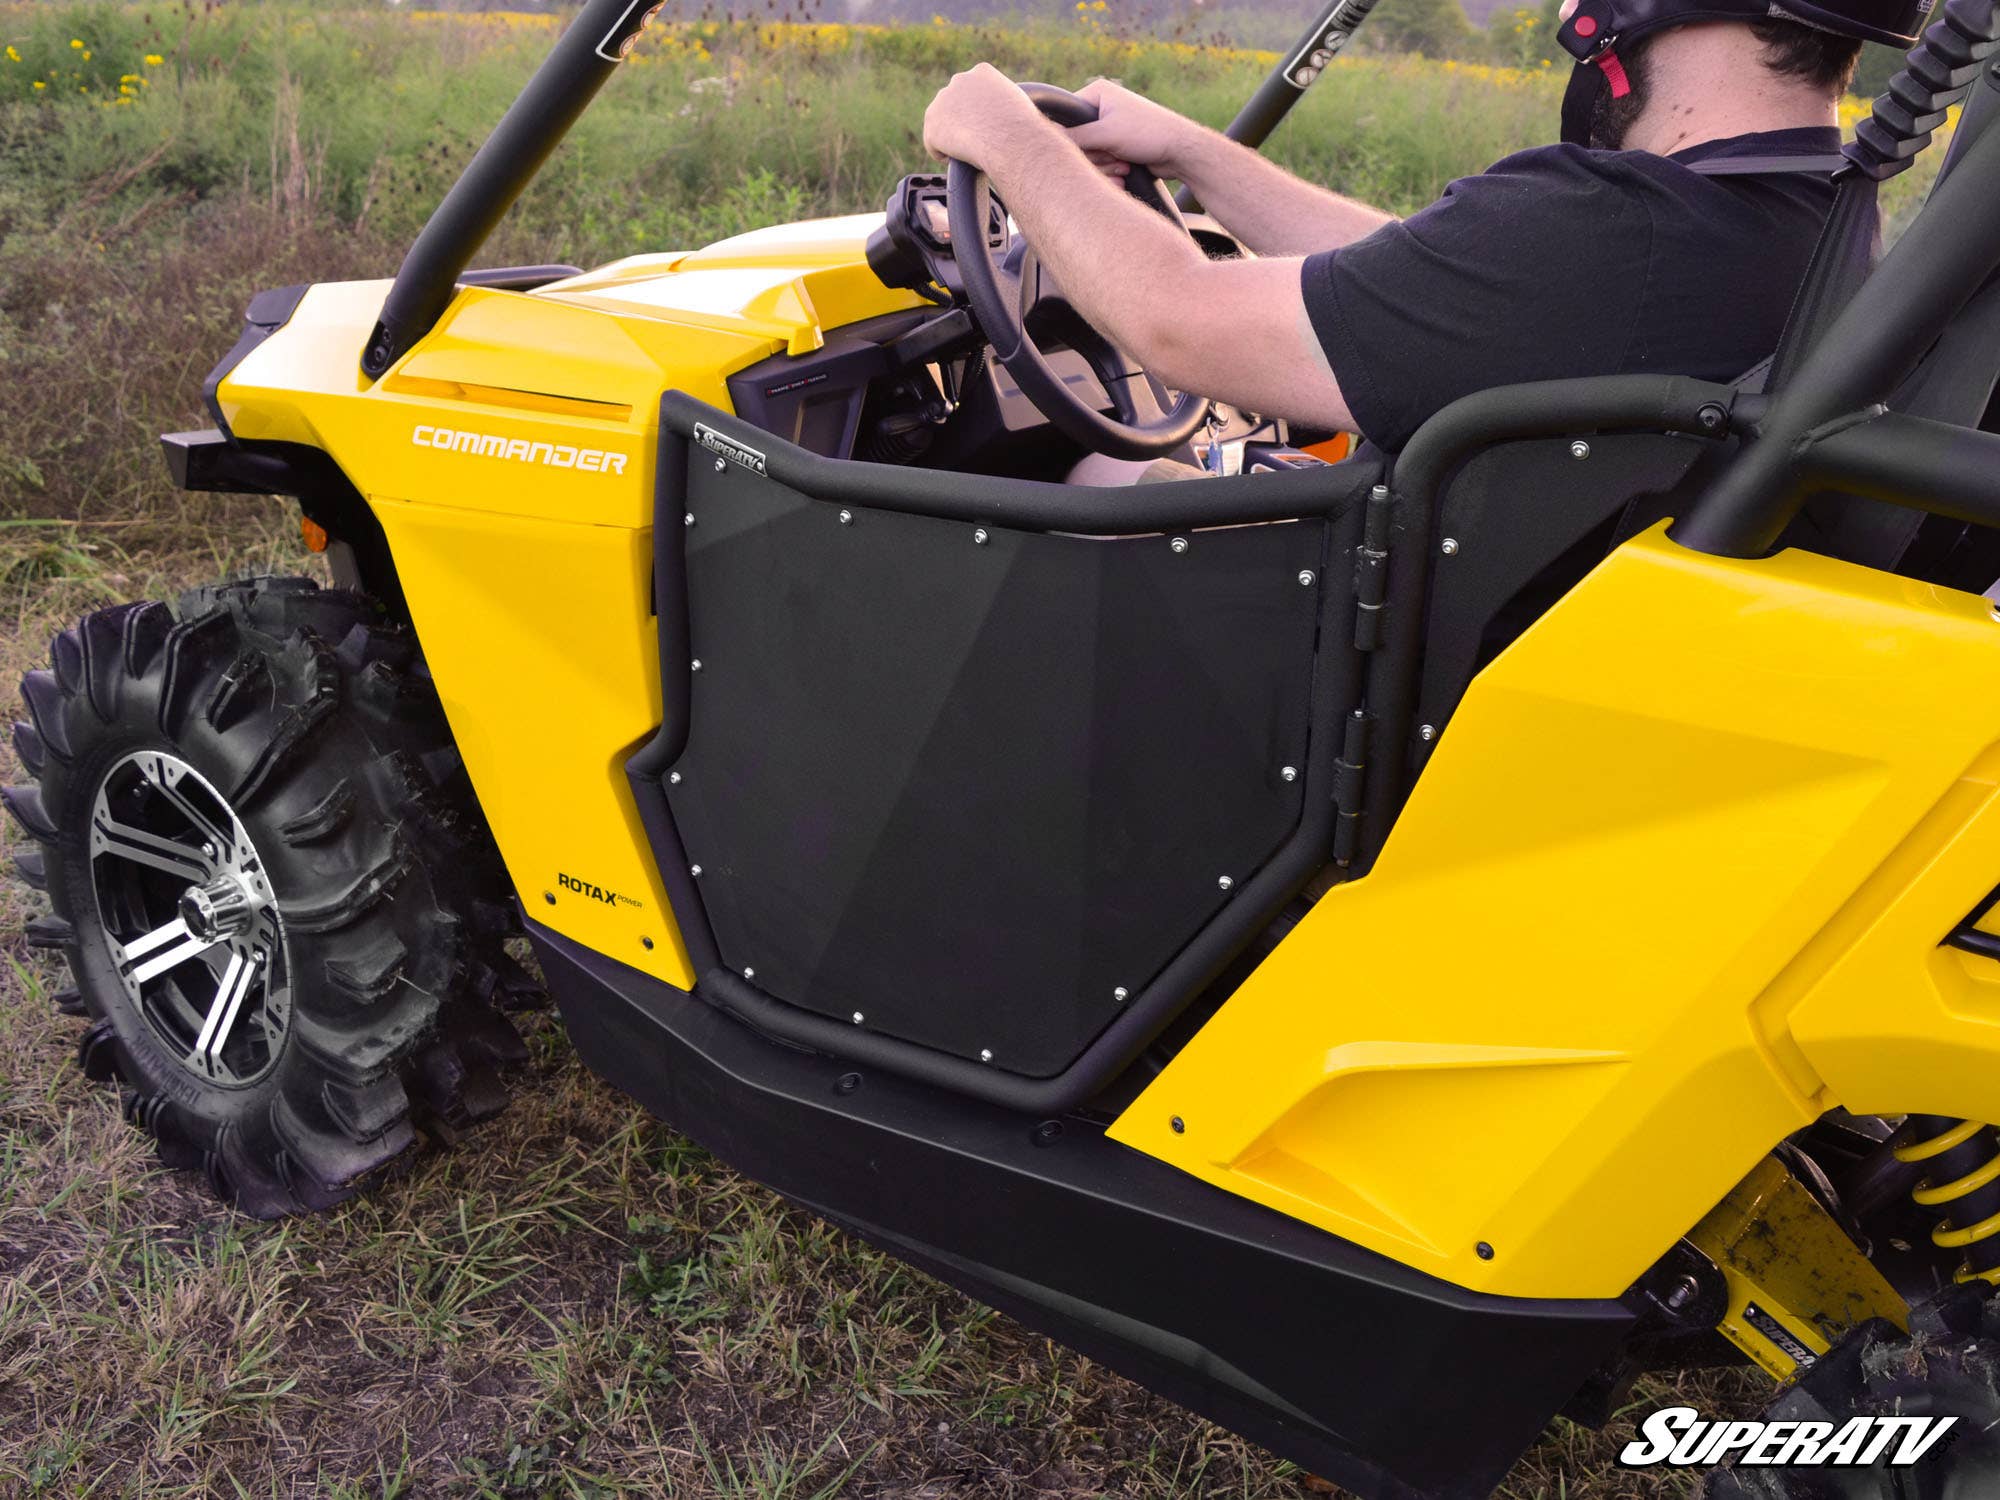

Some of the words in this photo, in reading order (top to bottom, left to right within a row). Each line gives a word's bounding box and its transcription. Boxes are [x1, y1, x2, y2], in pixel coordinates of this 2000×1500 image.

[412, 425, 628, 474] COMMANDER
[703, 432, 760, 468] SUPERATV
[558, 872, 616, 907] ROTAX
[617, 894, 643, 908] POWER
